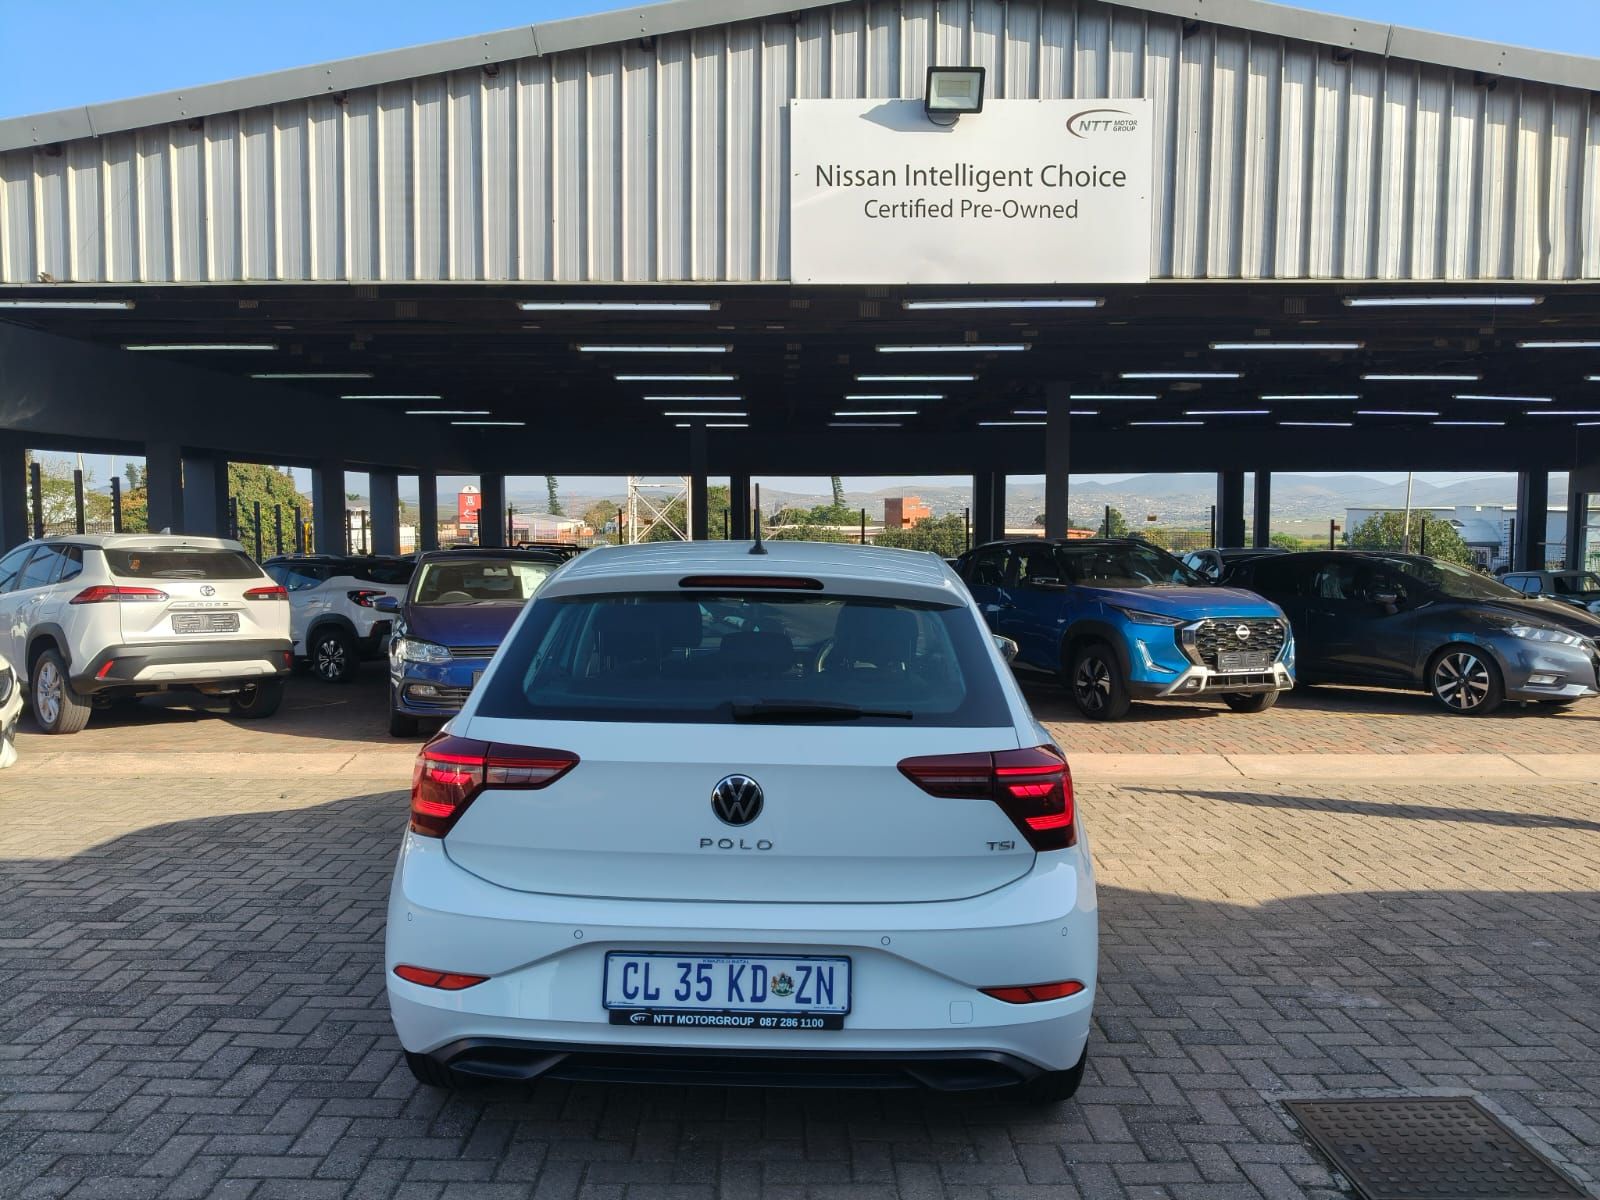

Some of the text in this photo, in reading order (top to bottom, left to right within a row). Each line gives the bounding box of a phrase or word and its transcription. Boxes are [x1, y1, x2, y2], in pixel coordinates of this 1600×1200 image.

[1079, 120, 1112, 131] NTT
[815, 163, 1127, 192] Nissan Intelligent Choice
[864, 199, 1078, 219] Certified Pre-Owned
[699, 838, 773, 851] POLO
[986, 840, 1015, 851] TSI
[622, 961, 834, 1005] CL 35 KD ZN
[653, 1014, 674, 1025] NTT
[676, 1015, 755, 1026] MOTORGROUP
[759, 1017, 777, 1027] 087
[779, 1017, 798, 1027] 286
[800, 1018, 824, 1028] 1100
